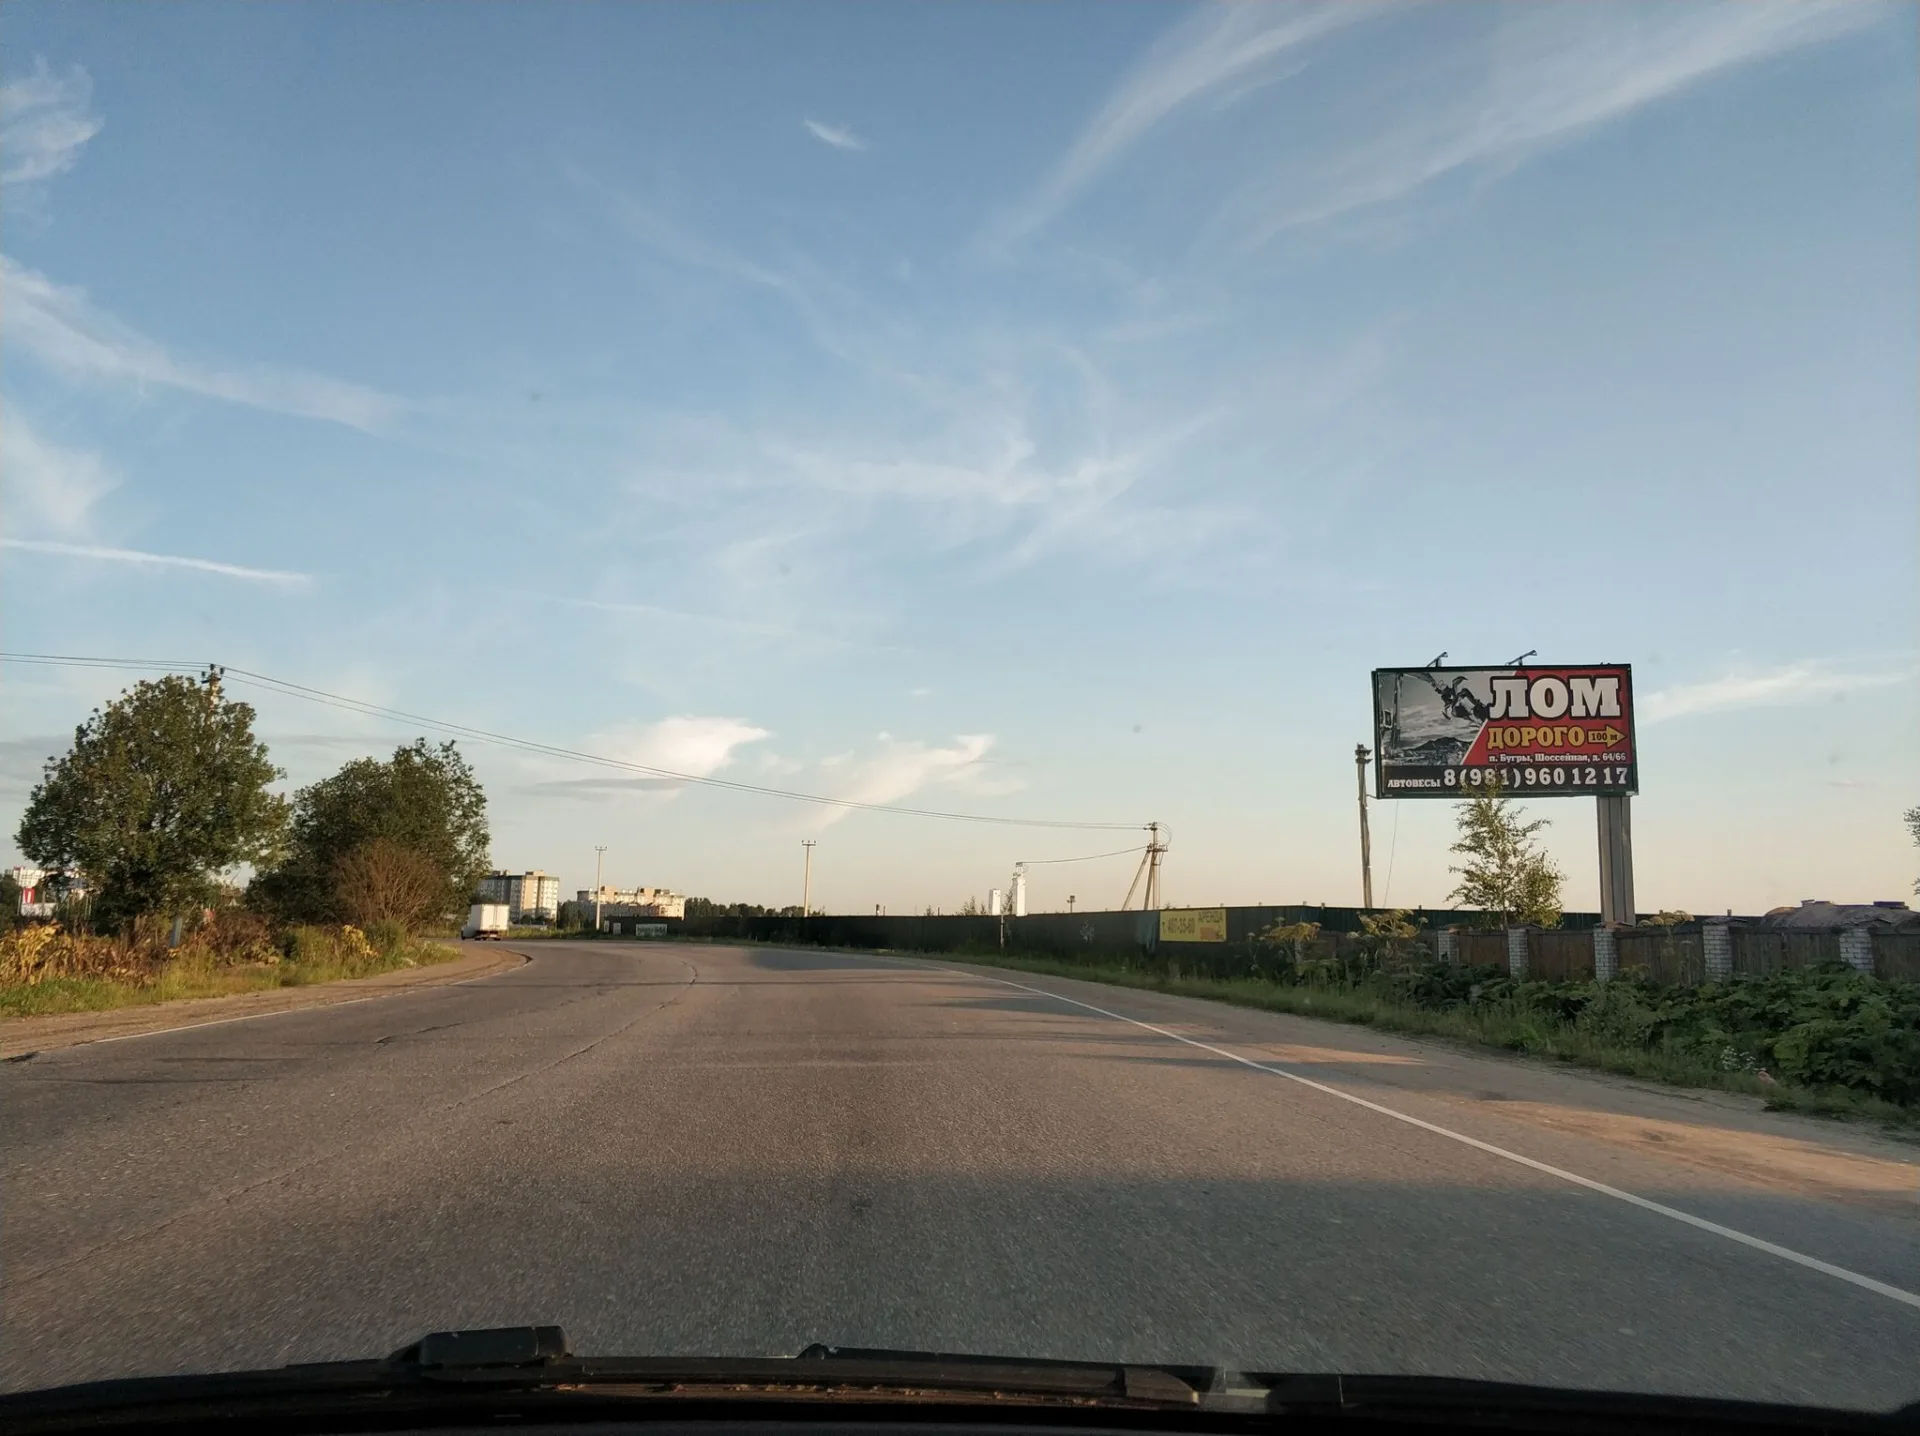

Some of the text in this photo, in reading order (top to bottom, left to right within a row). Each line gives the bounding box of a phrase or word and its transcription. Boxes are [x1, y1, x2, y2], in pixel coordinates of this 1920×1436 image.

[1489, 677, 1622, 719] ЛОМ
[1488, 726, 1585, 749] ДОРОГО
[1591, 732, 1608, 741] 100
[1488, 755, 1499, 763] п.
[1500, 754, 1534, 764] Бугры,
[1535, 753, 1590, 763] Шоссейная,
[1602, 752, 1626, 761] 64/66
[1387, 779, 1441, 788] АВТОВЕСЫ
